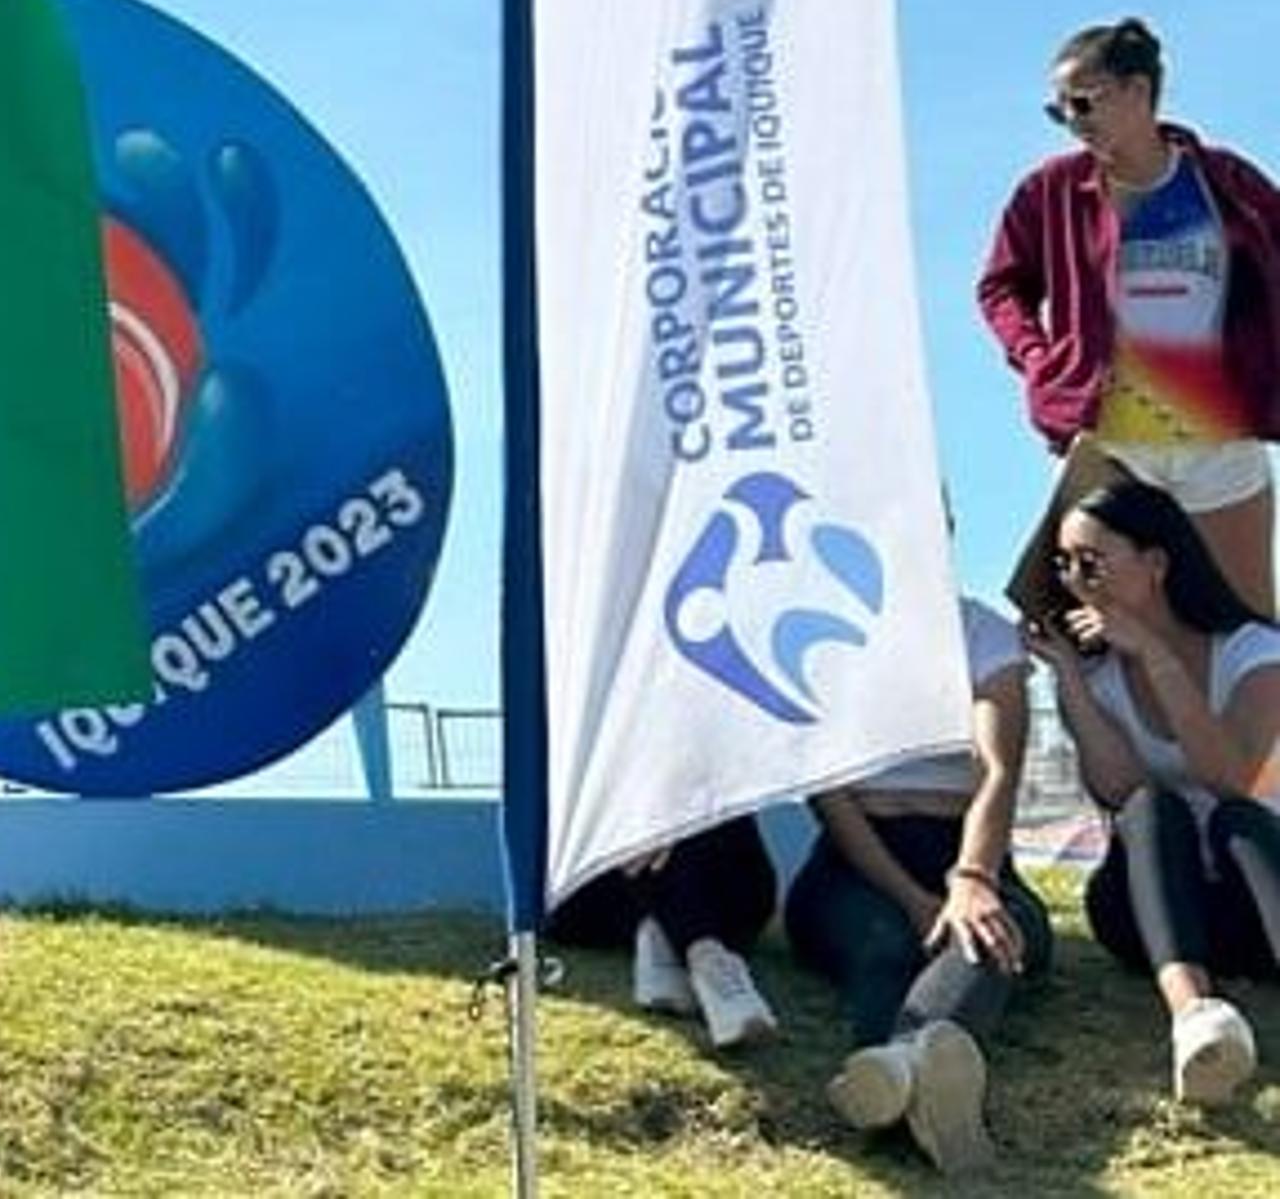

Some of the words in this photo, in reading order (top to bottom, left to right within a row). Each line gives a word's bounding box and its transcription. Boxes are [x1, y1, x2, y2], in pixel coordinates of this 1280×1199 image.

[671, 22, 777, 451] MUNICIPAL
[757, 155, 787, 203] DE
[769, 212, 807, 388] DEPORTES
[788, 400, 814, 442] DE
[35, 576, 277, 770] IQQUE
[266, 468, 425, 608] 2023
